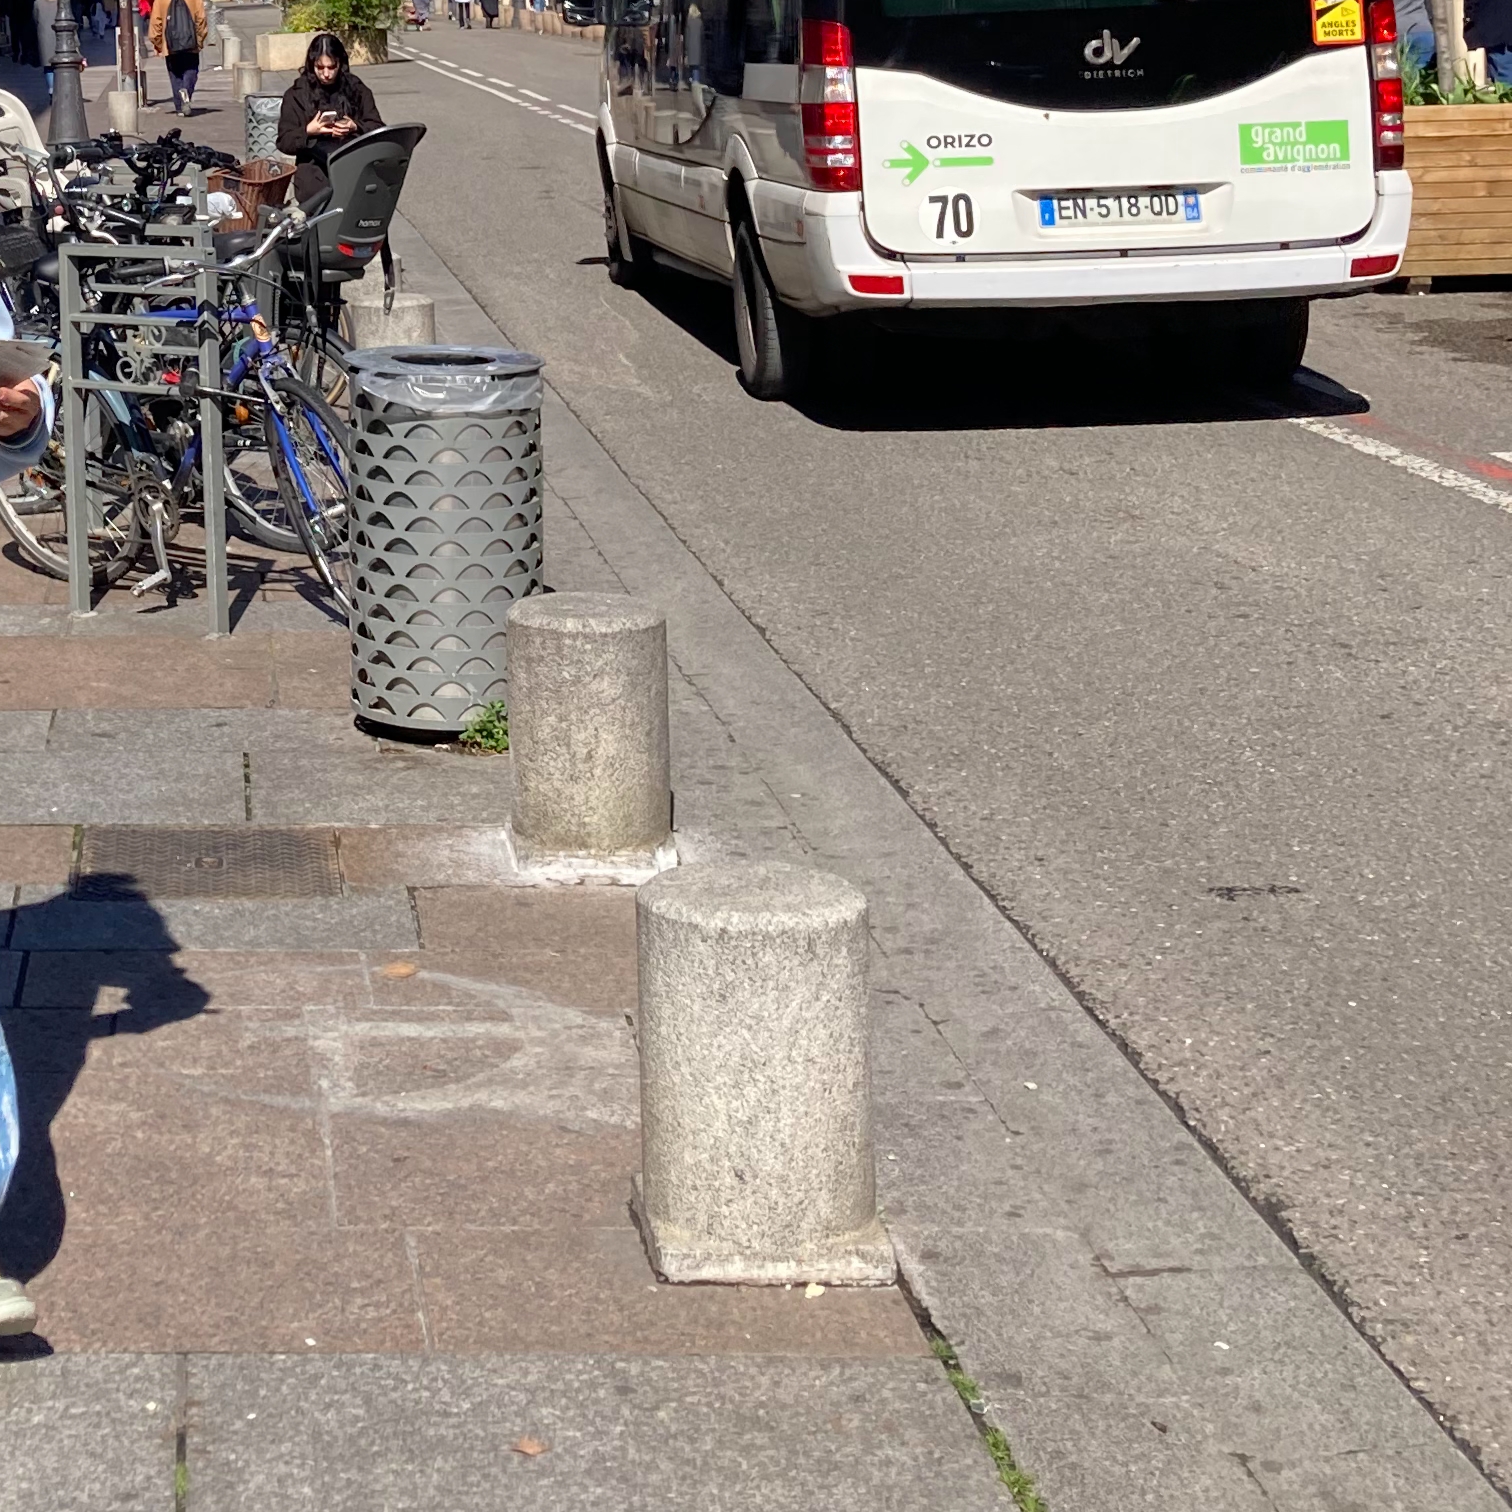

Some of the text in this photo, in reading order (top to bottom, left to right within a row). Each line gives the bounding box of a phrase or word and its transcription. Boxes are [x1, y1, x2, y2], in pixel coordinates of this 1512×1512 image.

[1321, 20, 1357, 29] ANGLES
[1323, 29, 1356, 38] MORTS
[926, 133, 993, 149] ORIZO
[1251, 121, 1307, 148] grand
[1262, 143, 1341, 163] avignon
[928, 193, 975, 239] 70
[1058, 194, 1179, 220] EN-518-QD
